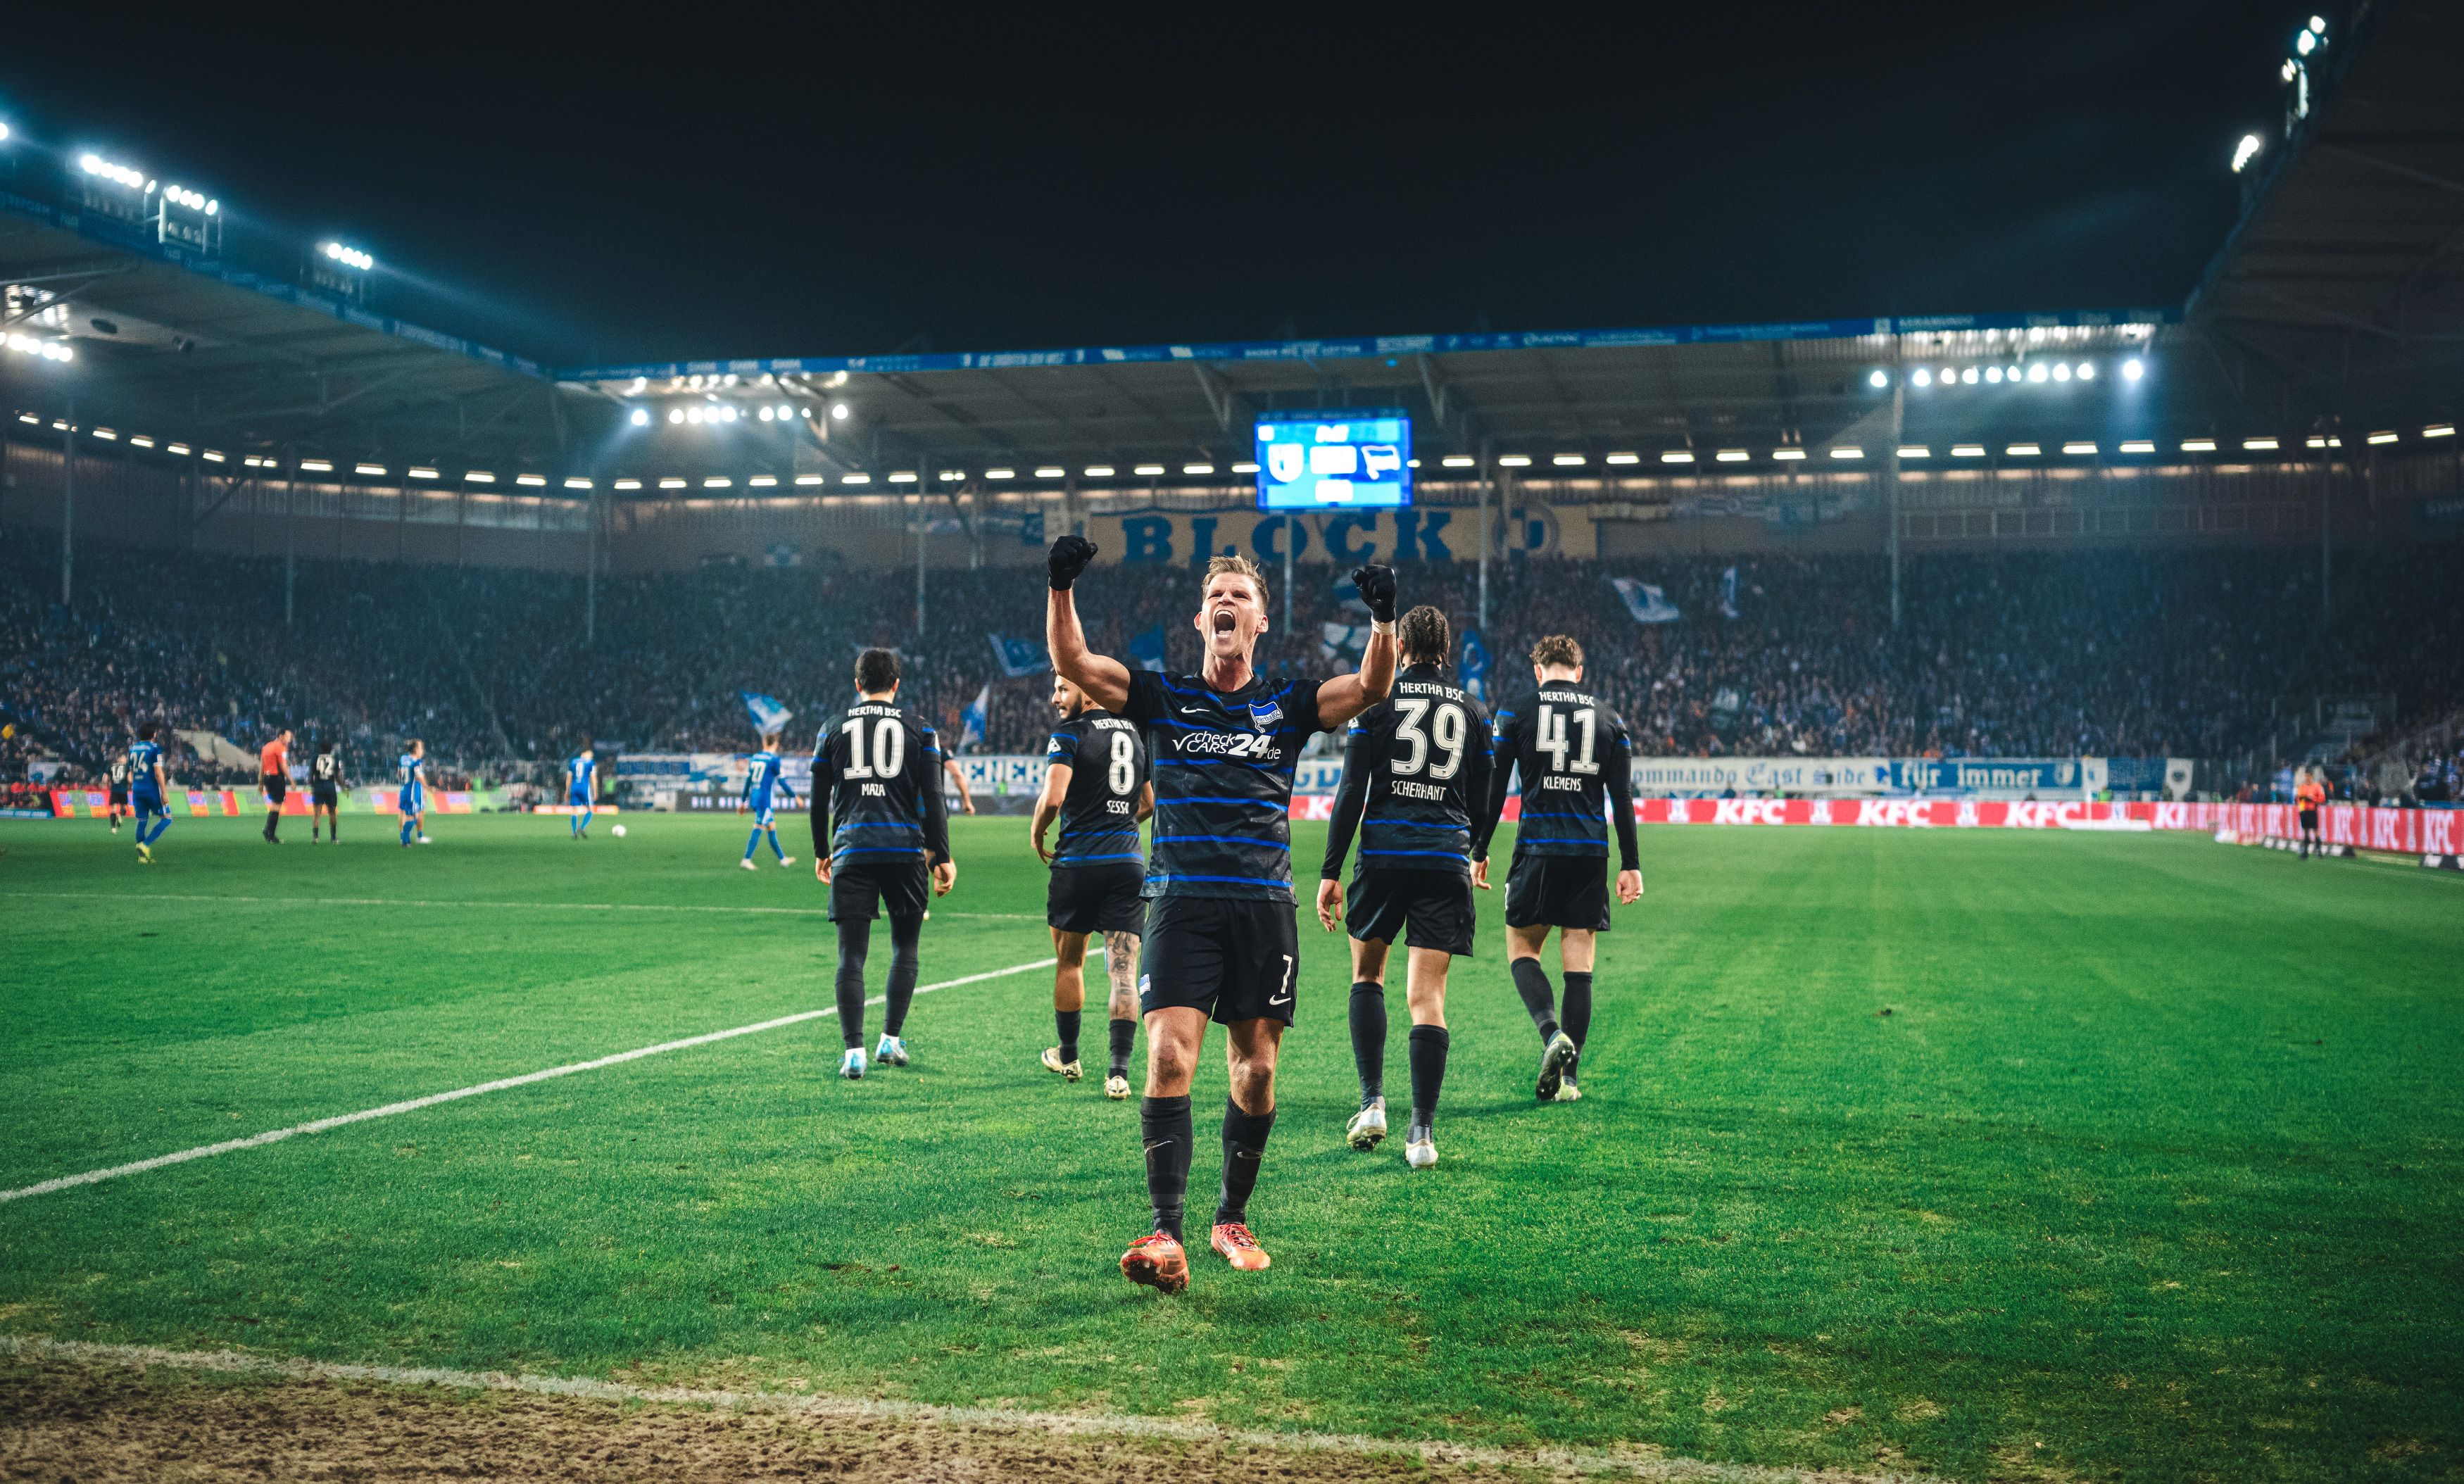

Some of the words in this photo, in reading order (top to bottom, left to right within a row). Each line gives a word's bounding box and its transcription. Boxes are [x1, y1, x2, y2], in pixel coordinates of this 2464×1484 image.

[1122, 512, 1451, 565] BLOCK
[1399, 681, 1443, 697] HERTHA
[1445, 686, 1465, 703] BSC
[1538, 691, 1577, 703] HERTHA
[1577, 693, 1595, 706] BSC
[848, 705, 884, 717] HERTHA
[884, 708, 902, 718] BSC
[1091, 718, 1124, 730] HERTHA
[842, 717, 905, 779] 10
[1187, 740, 1228, 754] CARS
[1195, 731, 1236, 745] check
[1390, 699, 1466, 779] 39
[1536, 705, 1599, 774] 41
[316, 757, 334, 776] 42
[1109, 731, 1135, 796] 8
[1632, 763, 1737, 784] ommando
[862, 783, 886, 796] MAZA
[1391, 780, 1447, 801] SCHERHANT
[1543, 776, 1582, 792] KLEMENS
[1106, 800, 1130, 815] SESSA
[1713, 800, 1786, 824] KFC
[1856, 800, 1931, 825] KFC
[2004, 800, 2082, 827] KFC
[2373, 807, 2399, 850] KFC
[2423, 810, 2455, 855] KFC
[1281, 954, 1293, 994] 7
